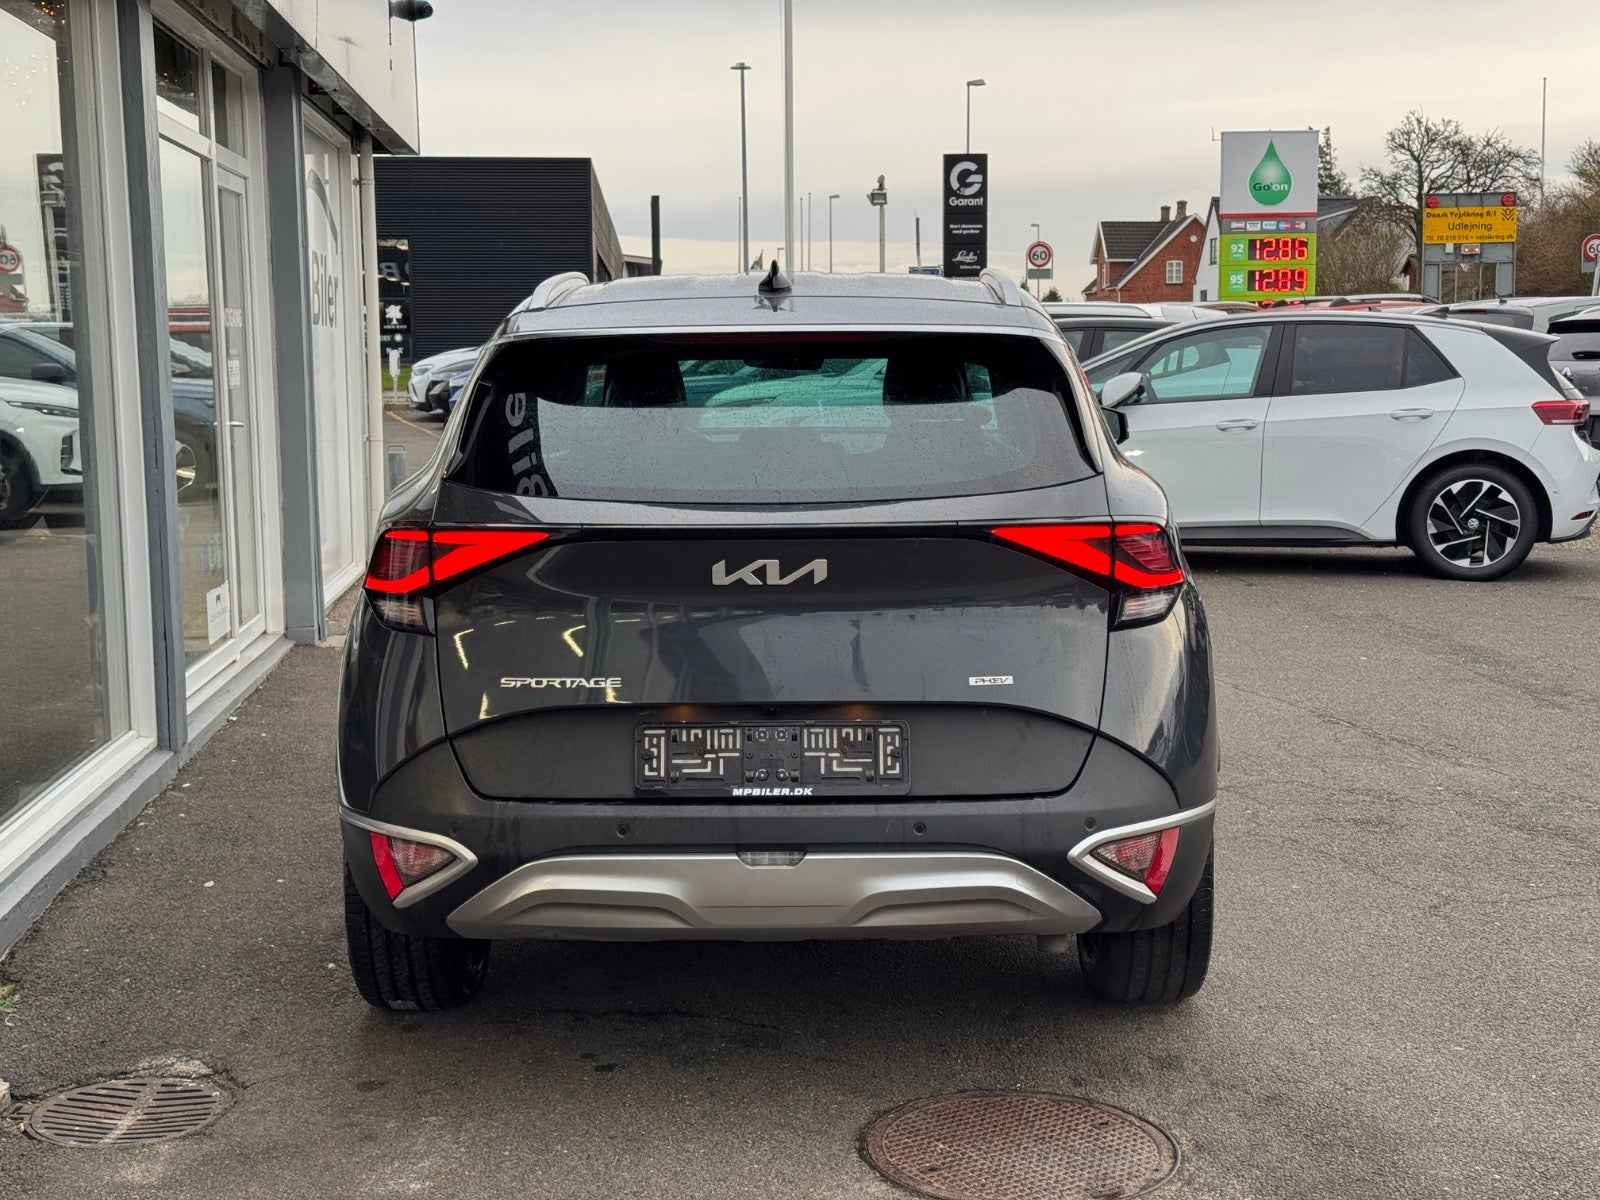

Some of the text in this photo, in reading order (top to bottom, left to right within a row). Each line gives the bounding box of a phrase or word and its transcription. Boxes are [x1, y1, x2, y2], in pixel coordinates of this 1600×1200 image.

[1252, 182, 1289, 192] Go'on
[949, 197, 984, 207] Garant
[1448, 222, 1493, 232] Udlejning
[1230, 243, 1245, 253] 92
[1032, 250, 1048, 261] 60
[1229, 274, 1244, 284] 95
[311, 250, 339, 328] Biler
[712, 559, 828, 586] KIA
[500, 677, 623, 689] SPORTAGE
[974, 677, 1009, 685] PHEV
[732, 787, 813, 797] MPBILER.DK
